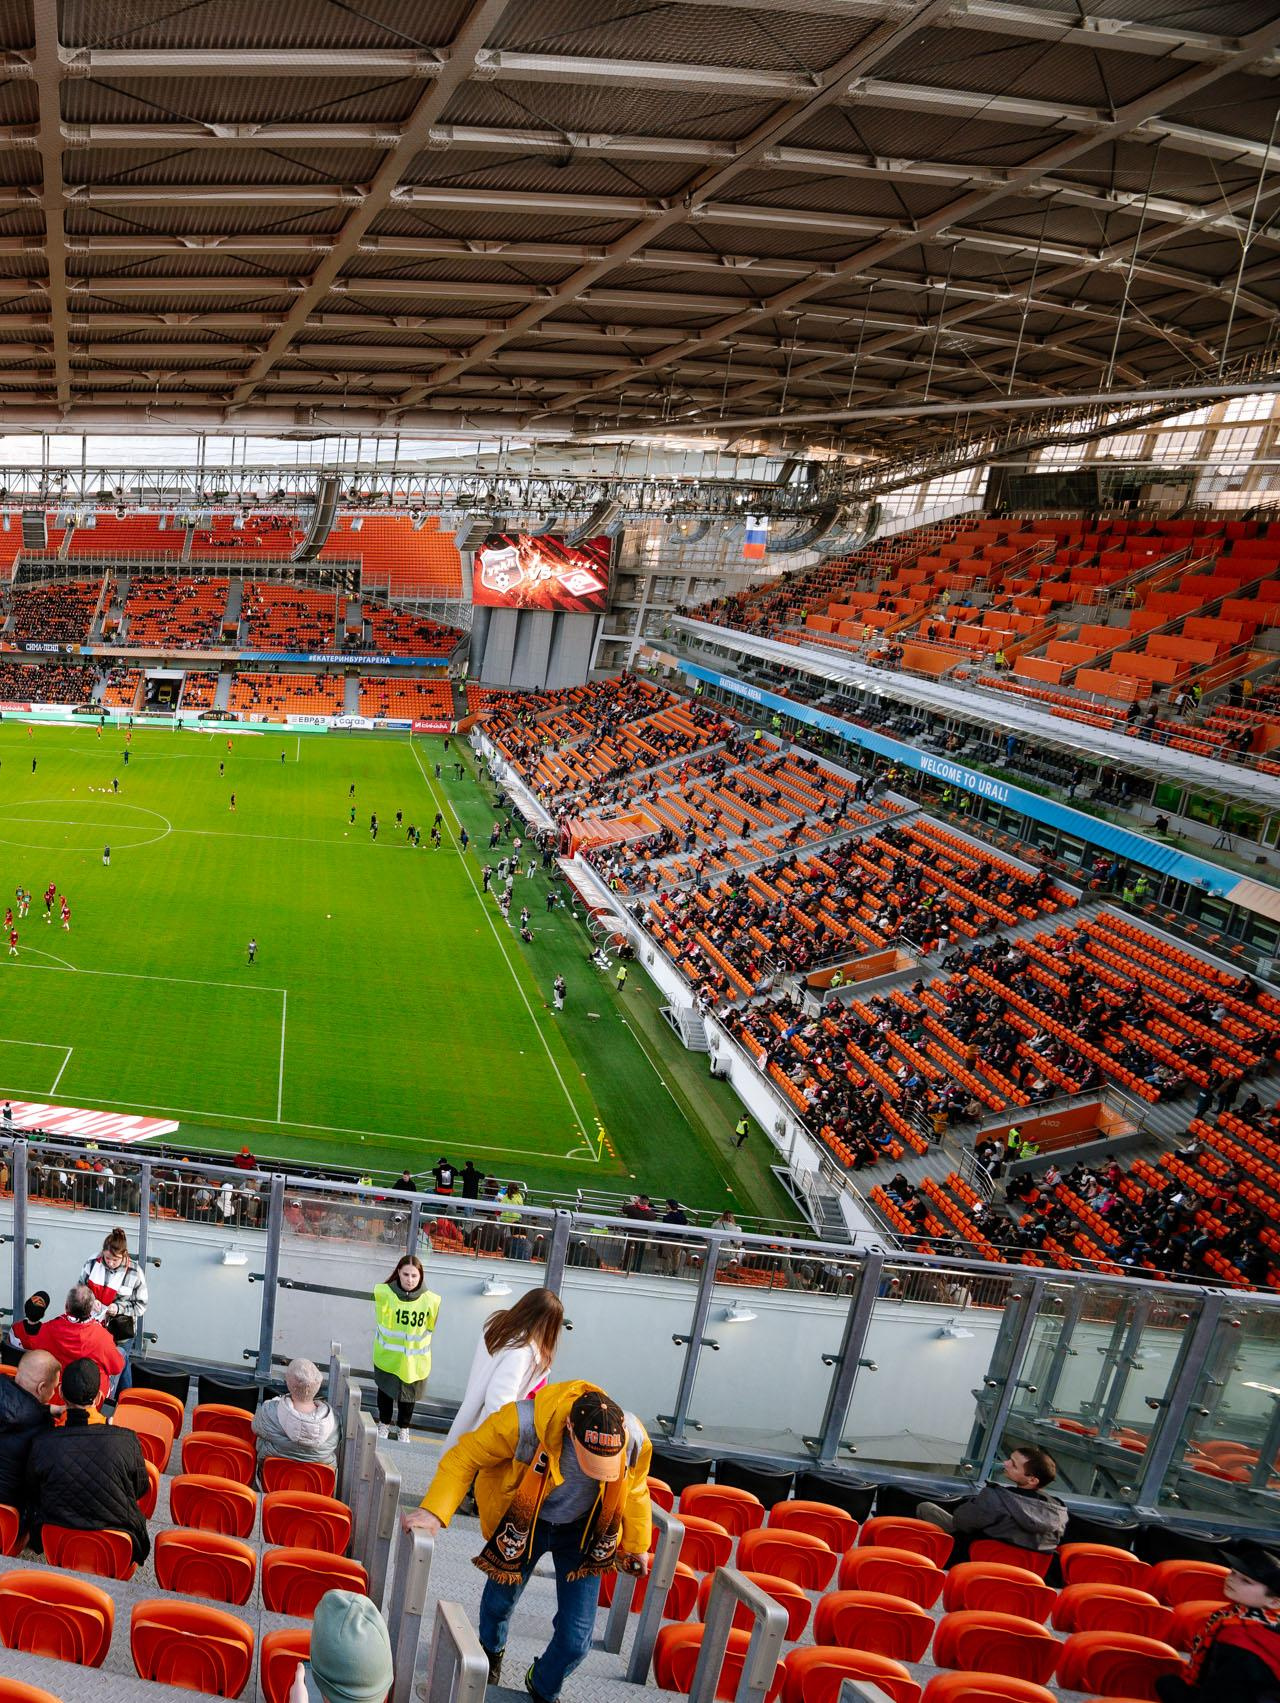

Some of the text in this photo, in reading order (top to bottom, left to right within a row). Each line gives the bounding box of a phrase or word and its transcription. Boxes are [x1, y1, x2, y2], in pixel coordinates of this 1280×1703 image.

[25, 643, 59, 652] СИМА-ЛЕНД
[309, 655, 391, 664] #ЕКАТЕРИНБУРГАРЕНА
[298, 716, 326, 724] ЕВРАЗ
[920, 756, 1009, 802] WELCOME TO URAL!
[1040, 1119, 1061, 1128] A102
[395, 1308, 430, 1328] 1538
[585, 1429, 622, 1447] FC URAL
